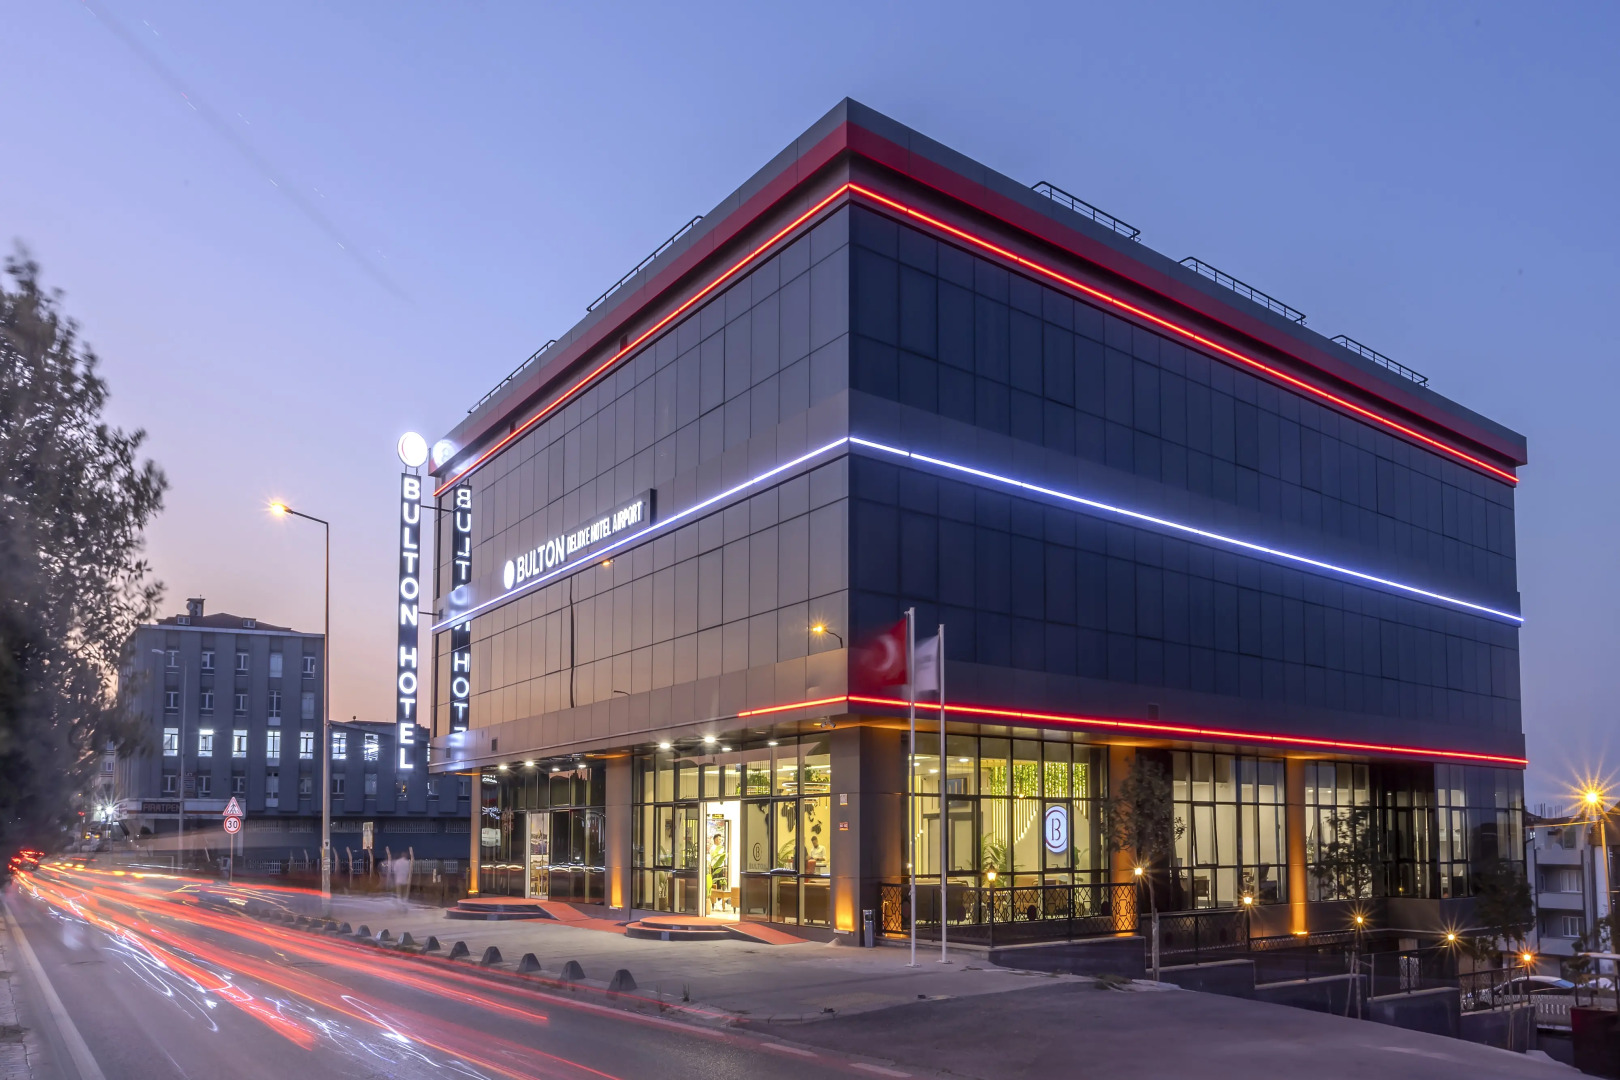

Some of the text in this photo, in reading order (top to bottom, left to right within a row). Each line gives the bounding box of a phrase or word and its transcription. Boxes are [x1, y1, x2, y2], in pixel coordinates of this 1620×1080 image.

[516, 501, 644, 583] BULTON DELUXE HOTEL AIRPORT
[398, 478, 420, 769] BULTON HOTEL
[227, 820, 238, 829] 30
[1051, 818, 1061, 841] B
